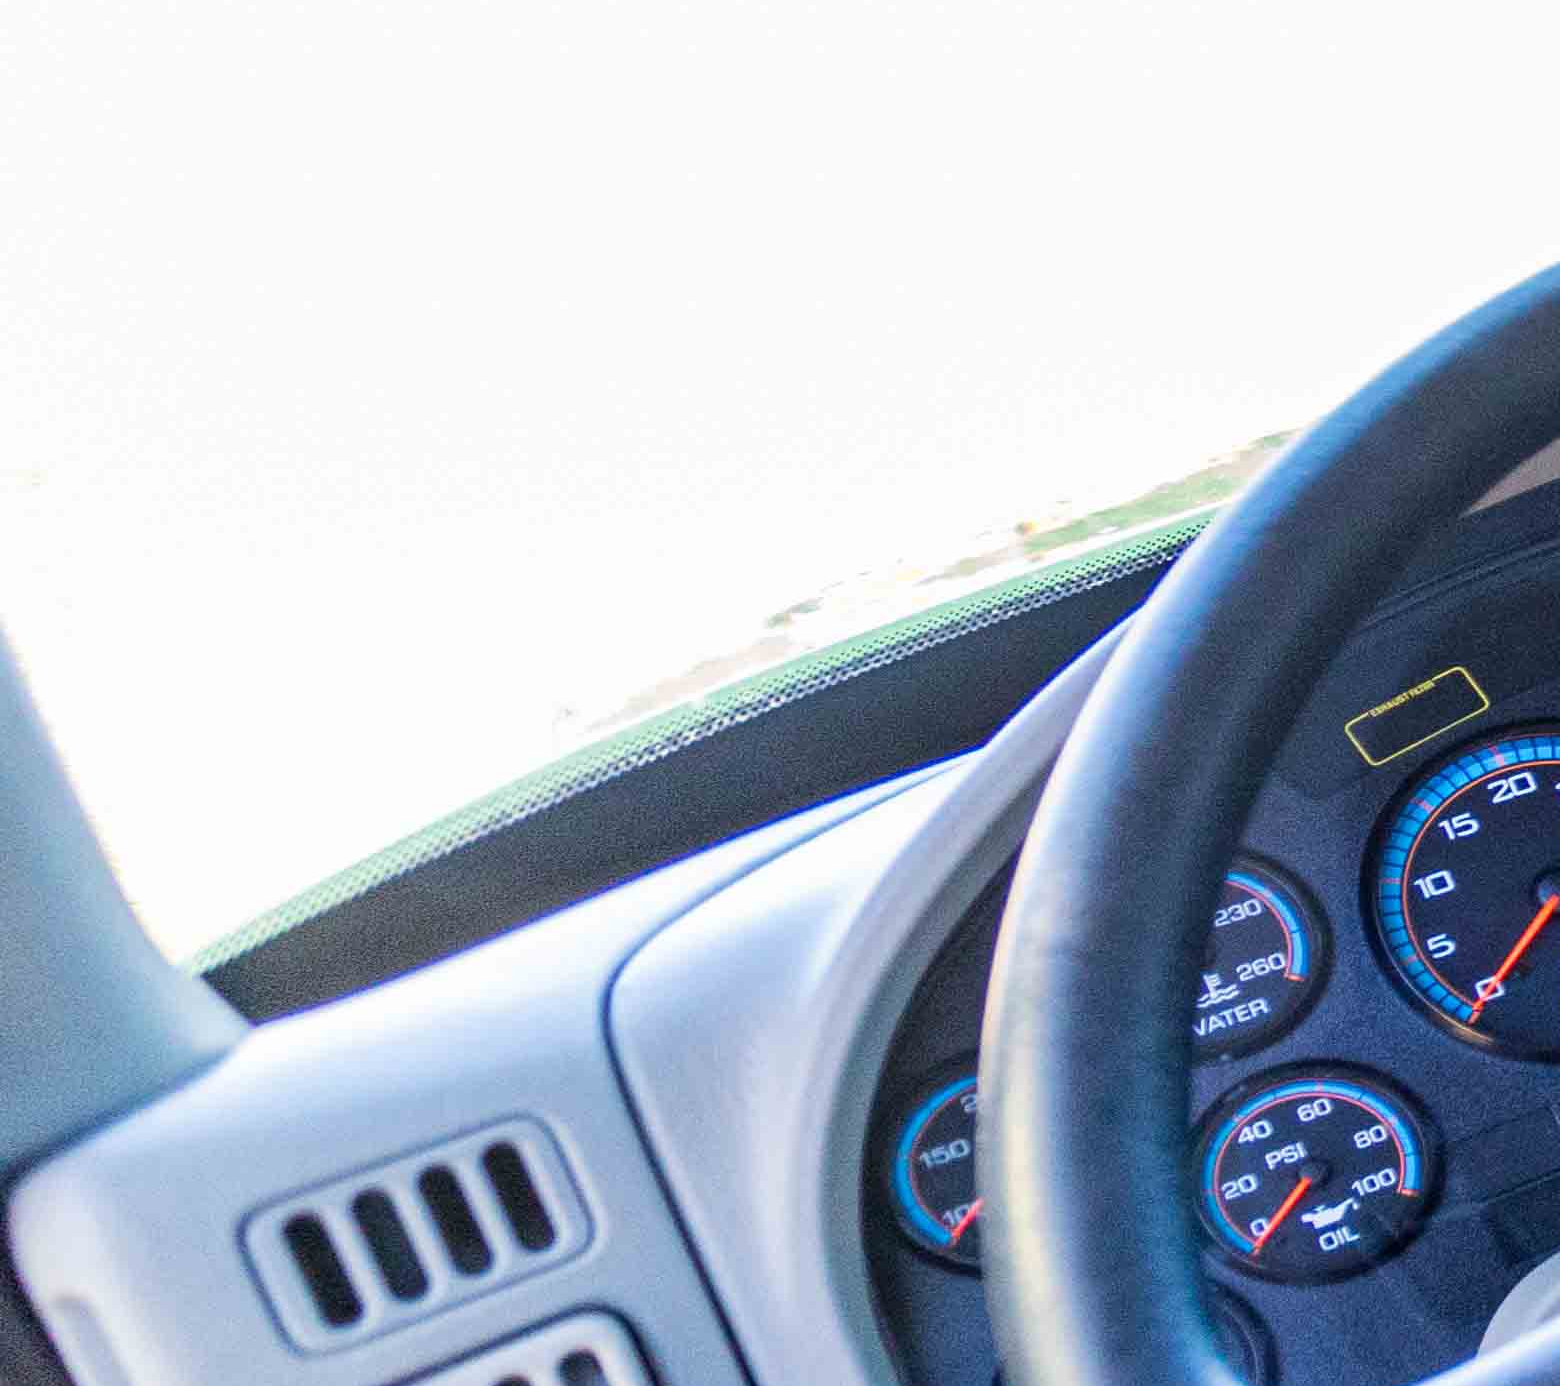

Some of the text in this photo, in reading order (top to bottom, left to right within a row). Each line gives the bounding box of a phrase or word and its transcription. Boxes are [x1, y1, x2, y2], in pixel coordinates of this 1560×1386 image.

[1487, 771, 1537, 804] 20
[1438, 812, 1479, 841] 15
[1413, 870, 1456, 899] 10
[1214, 899, 1263, 928] 230
[1426, 933, 1456, 959] 5
[1236, 952, 1286, 982] 260
[1474, 976, 1505, 1002] 0
[1297, 1098, 1333, 1122] 60
[1237, 1121, 1273, 1145] 40
[1354, 1124, 1388, 1149] 80
[920, 1139, 971, 1168] 150
[1264, 1141, 1308, 1171] PSI
[1221, 1174, 1258, 1201] 20
[1351, 1167, 1397, 1197] 100
[1250, 1218, 1270, 1238] 0
[1318, 1227, 1361, 1252] OIL
